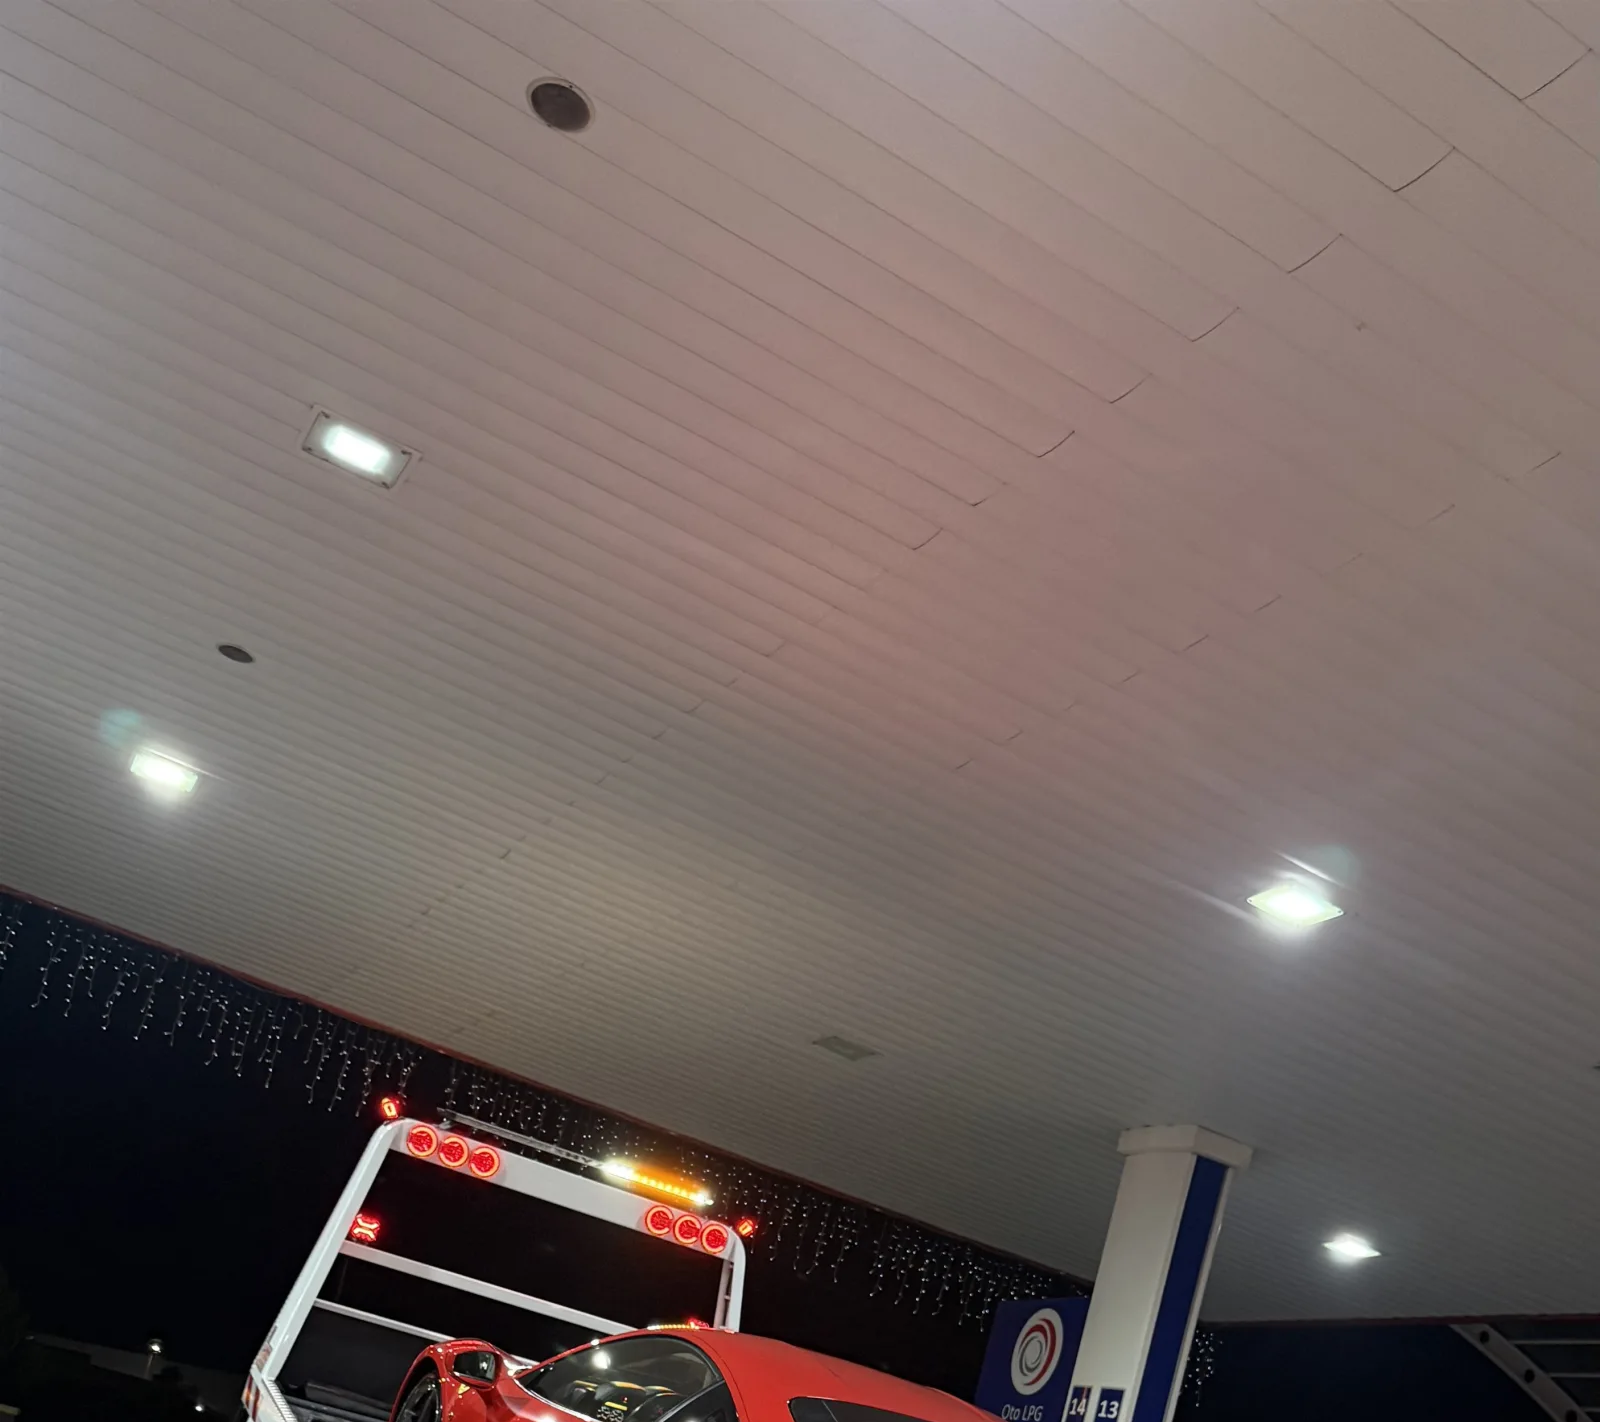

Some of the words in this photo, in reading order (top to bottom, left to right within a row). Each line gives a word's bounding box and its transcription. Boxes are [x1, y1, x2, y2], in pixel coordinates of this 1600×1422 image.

[1001, 1404, 1020, 1421] Oto
[1022, 1405, 1044, 1422] LPG
[1069, 1398, 1087, 1416] 14
[1098, 1400, 1119, 1419] 13
